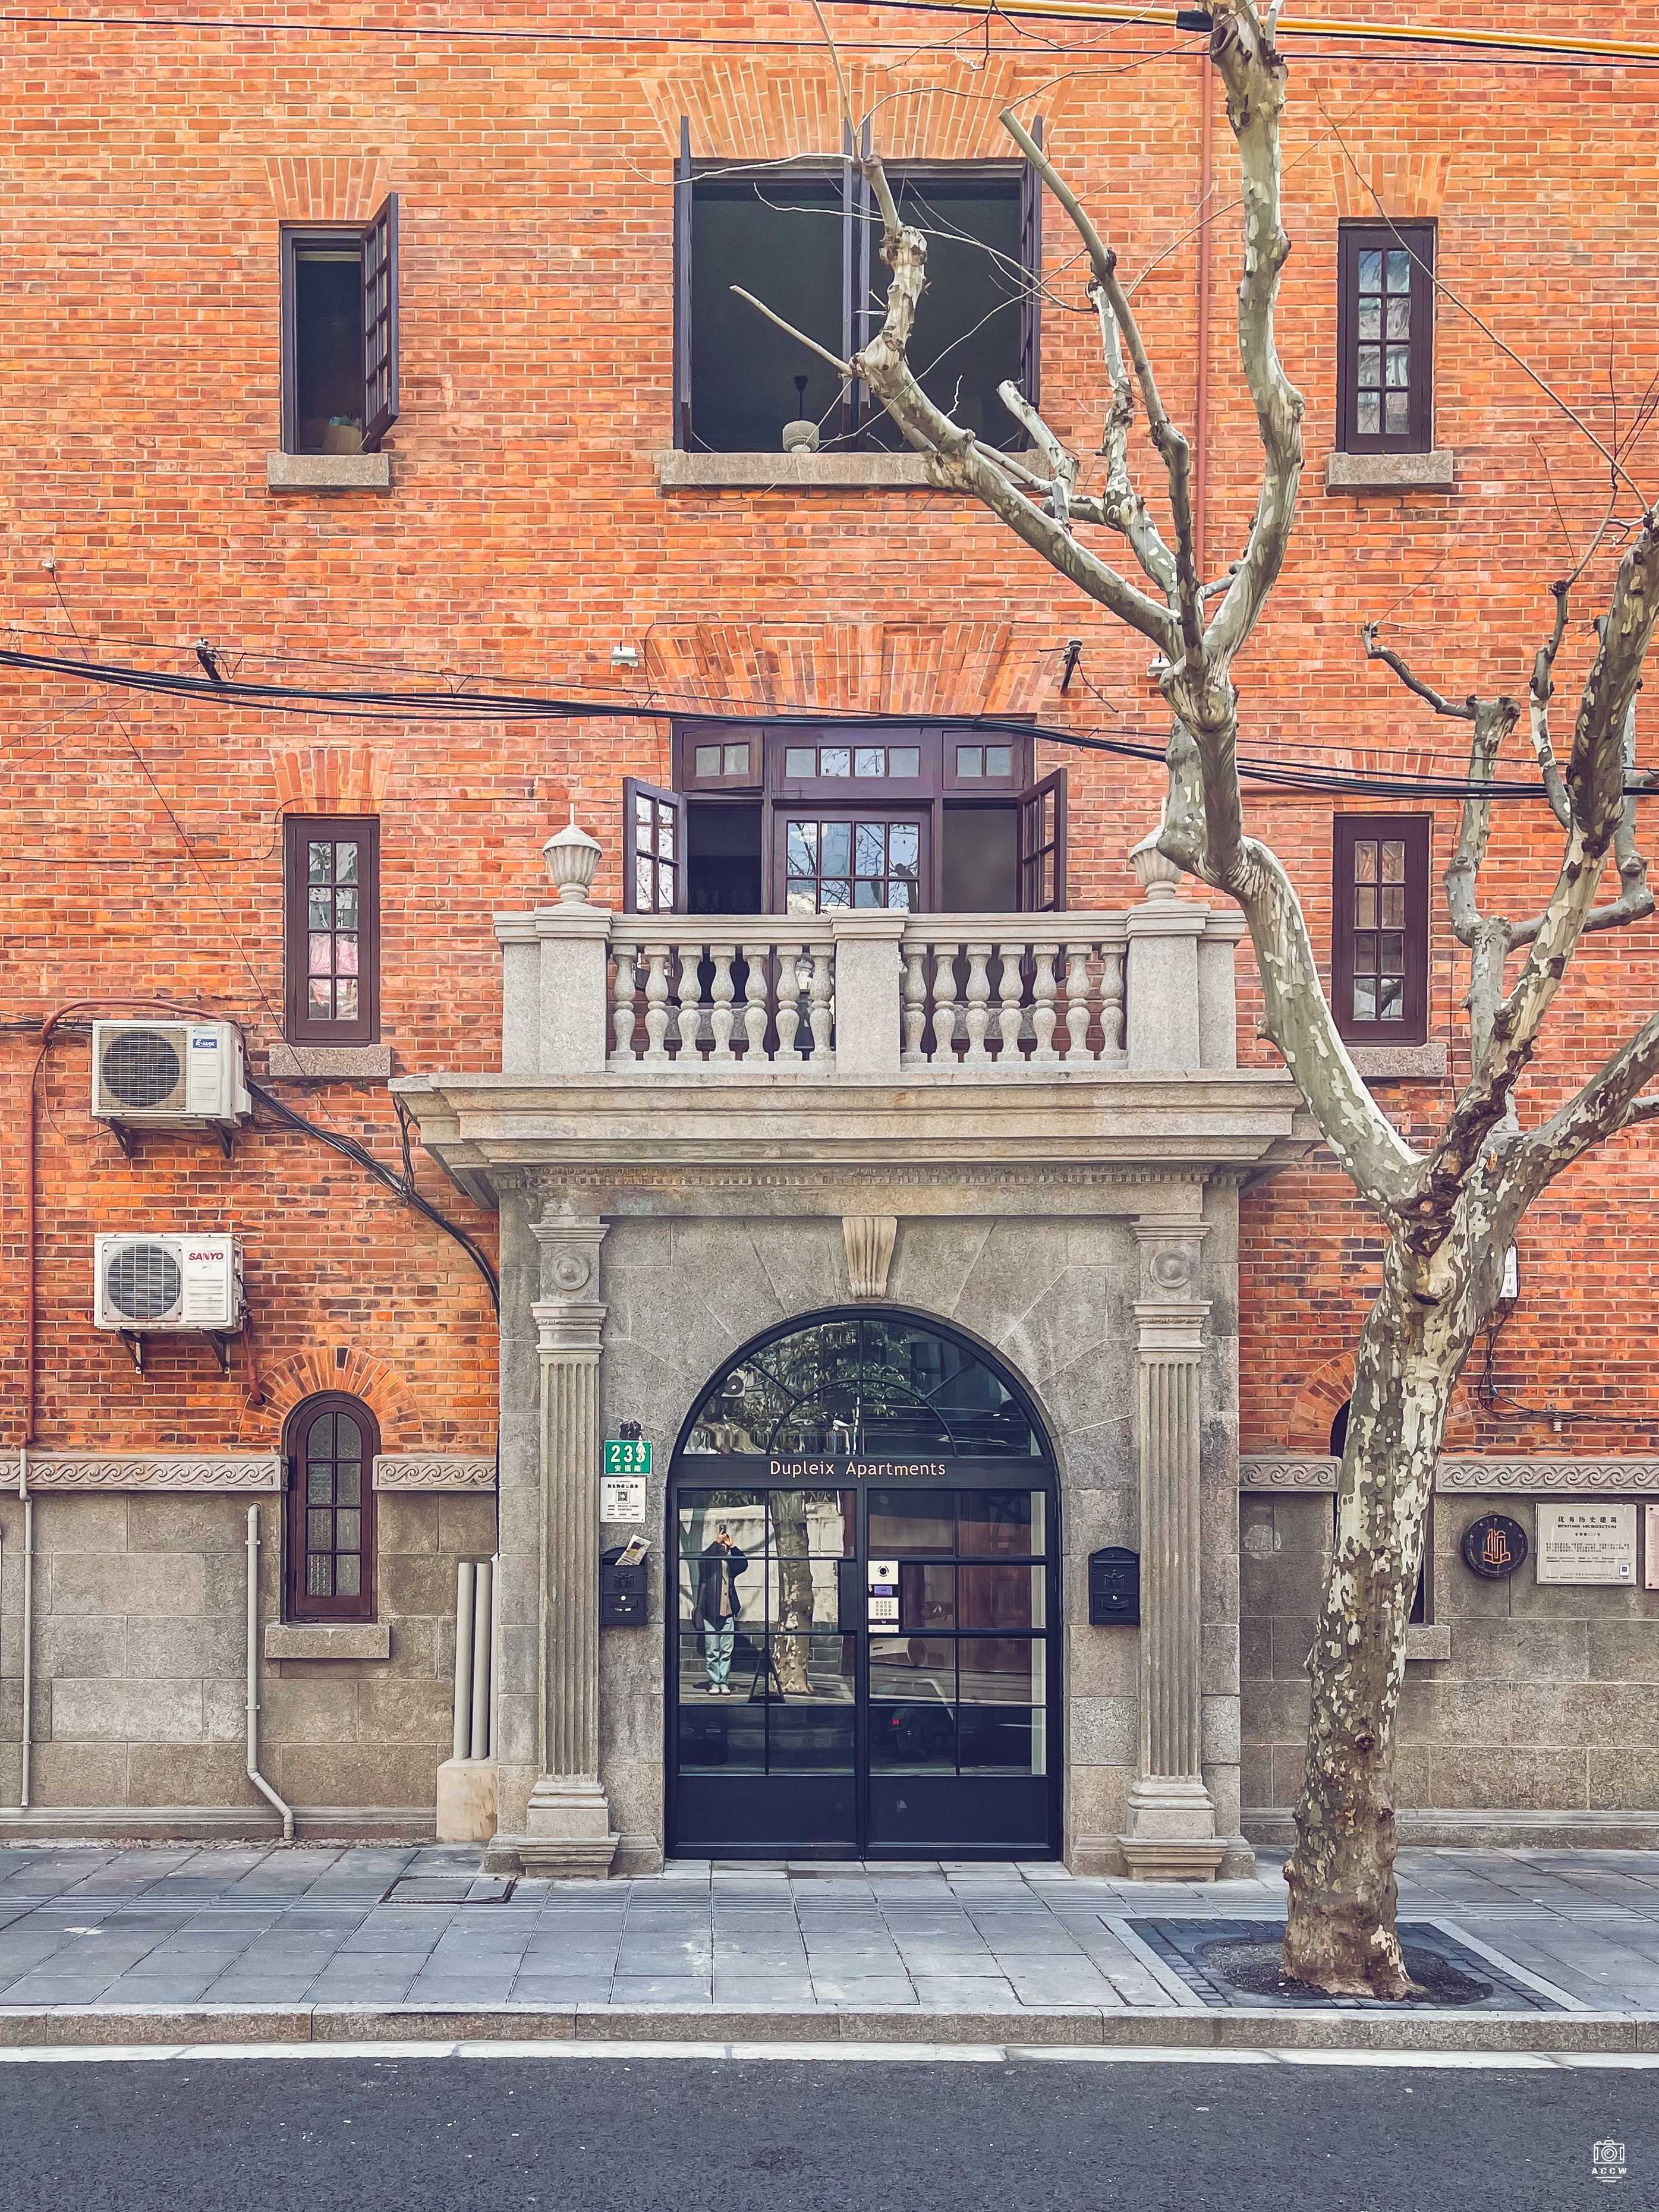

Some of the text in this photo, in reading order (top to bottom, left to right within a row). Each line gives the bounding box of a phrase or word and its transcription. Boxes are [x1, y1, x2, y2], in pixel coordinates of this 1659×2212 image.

[188, 1252, 224, 1261] SANYO
[770, 1461, 945, 1478] Dupleix Apartments
